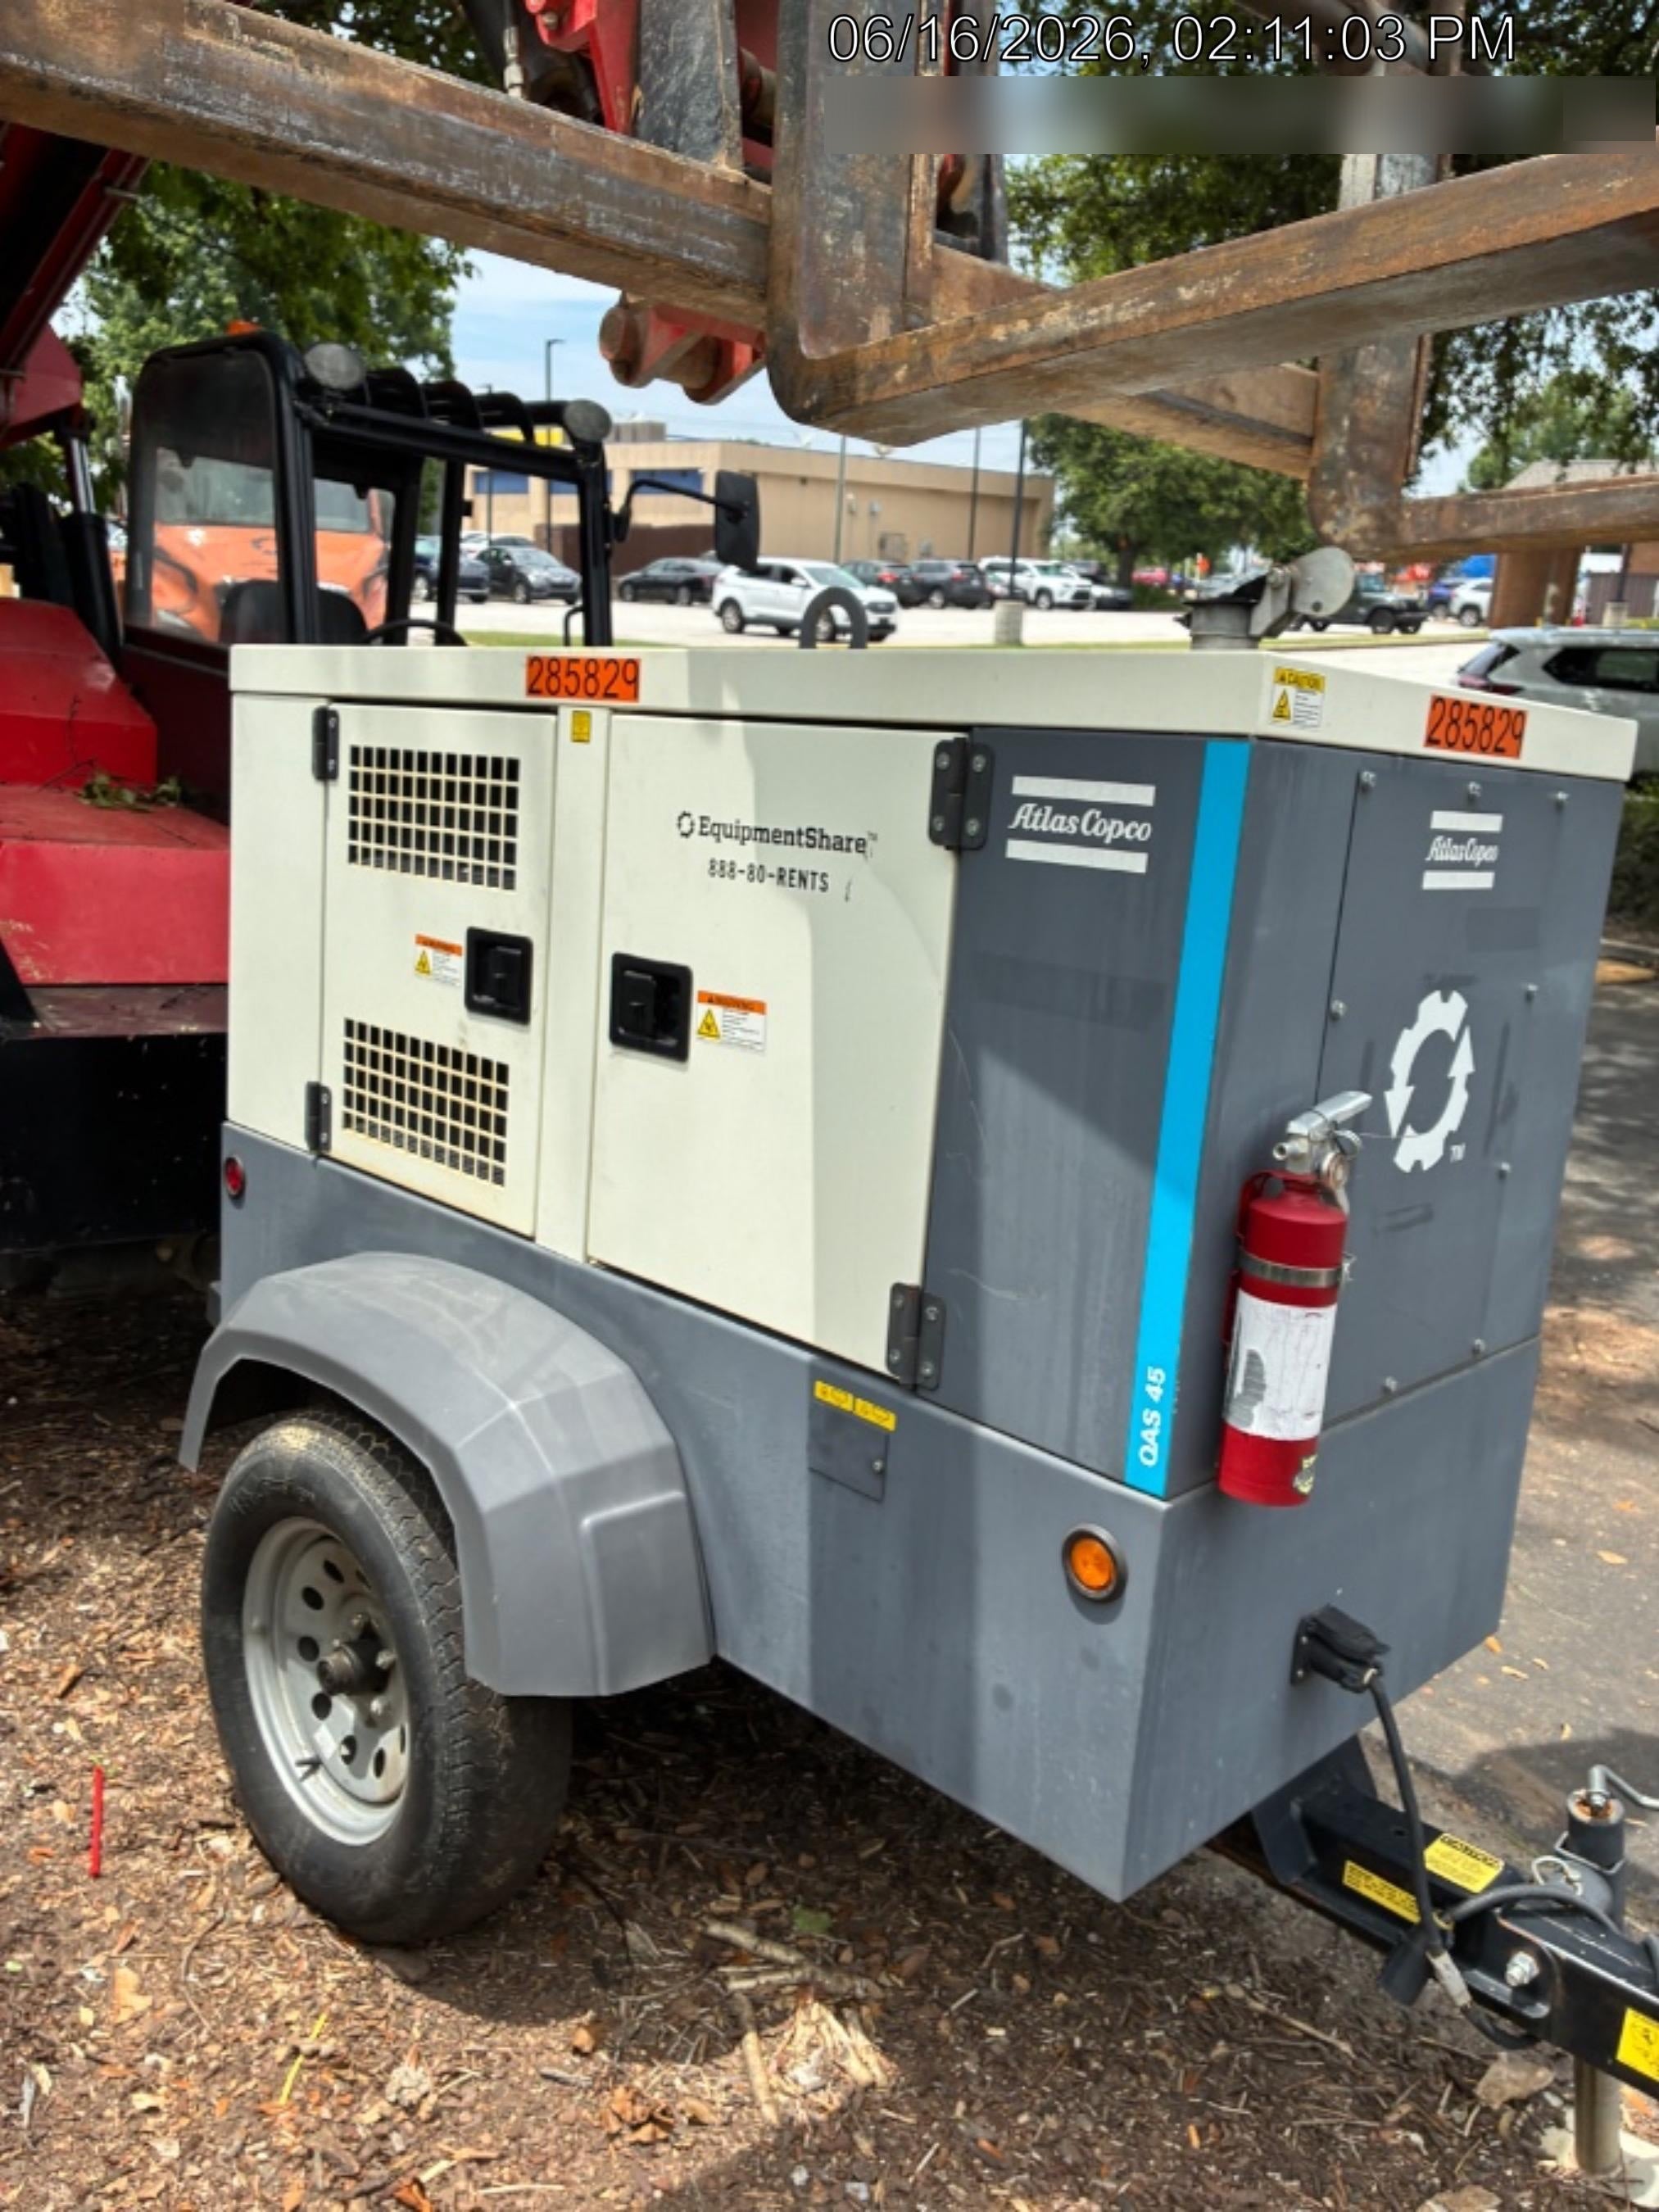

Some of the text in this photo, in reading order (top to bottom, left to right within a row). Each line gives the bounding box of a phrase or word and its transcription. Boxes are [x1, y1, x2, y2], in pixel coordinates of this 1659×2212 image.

[527, 656, 640, 702] 285829
[1426, 696, 1525, 758] 285829
[708, 858, 829, 893] 888-80-RENTS
[1137, 1366, 1166, 1466] QAS 45
